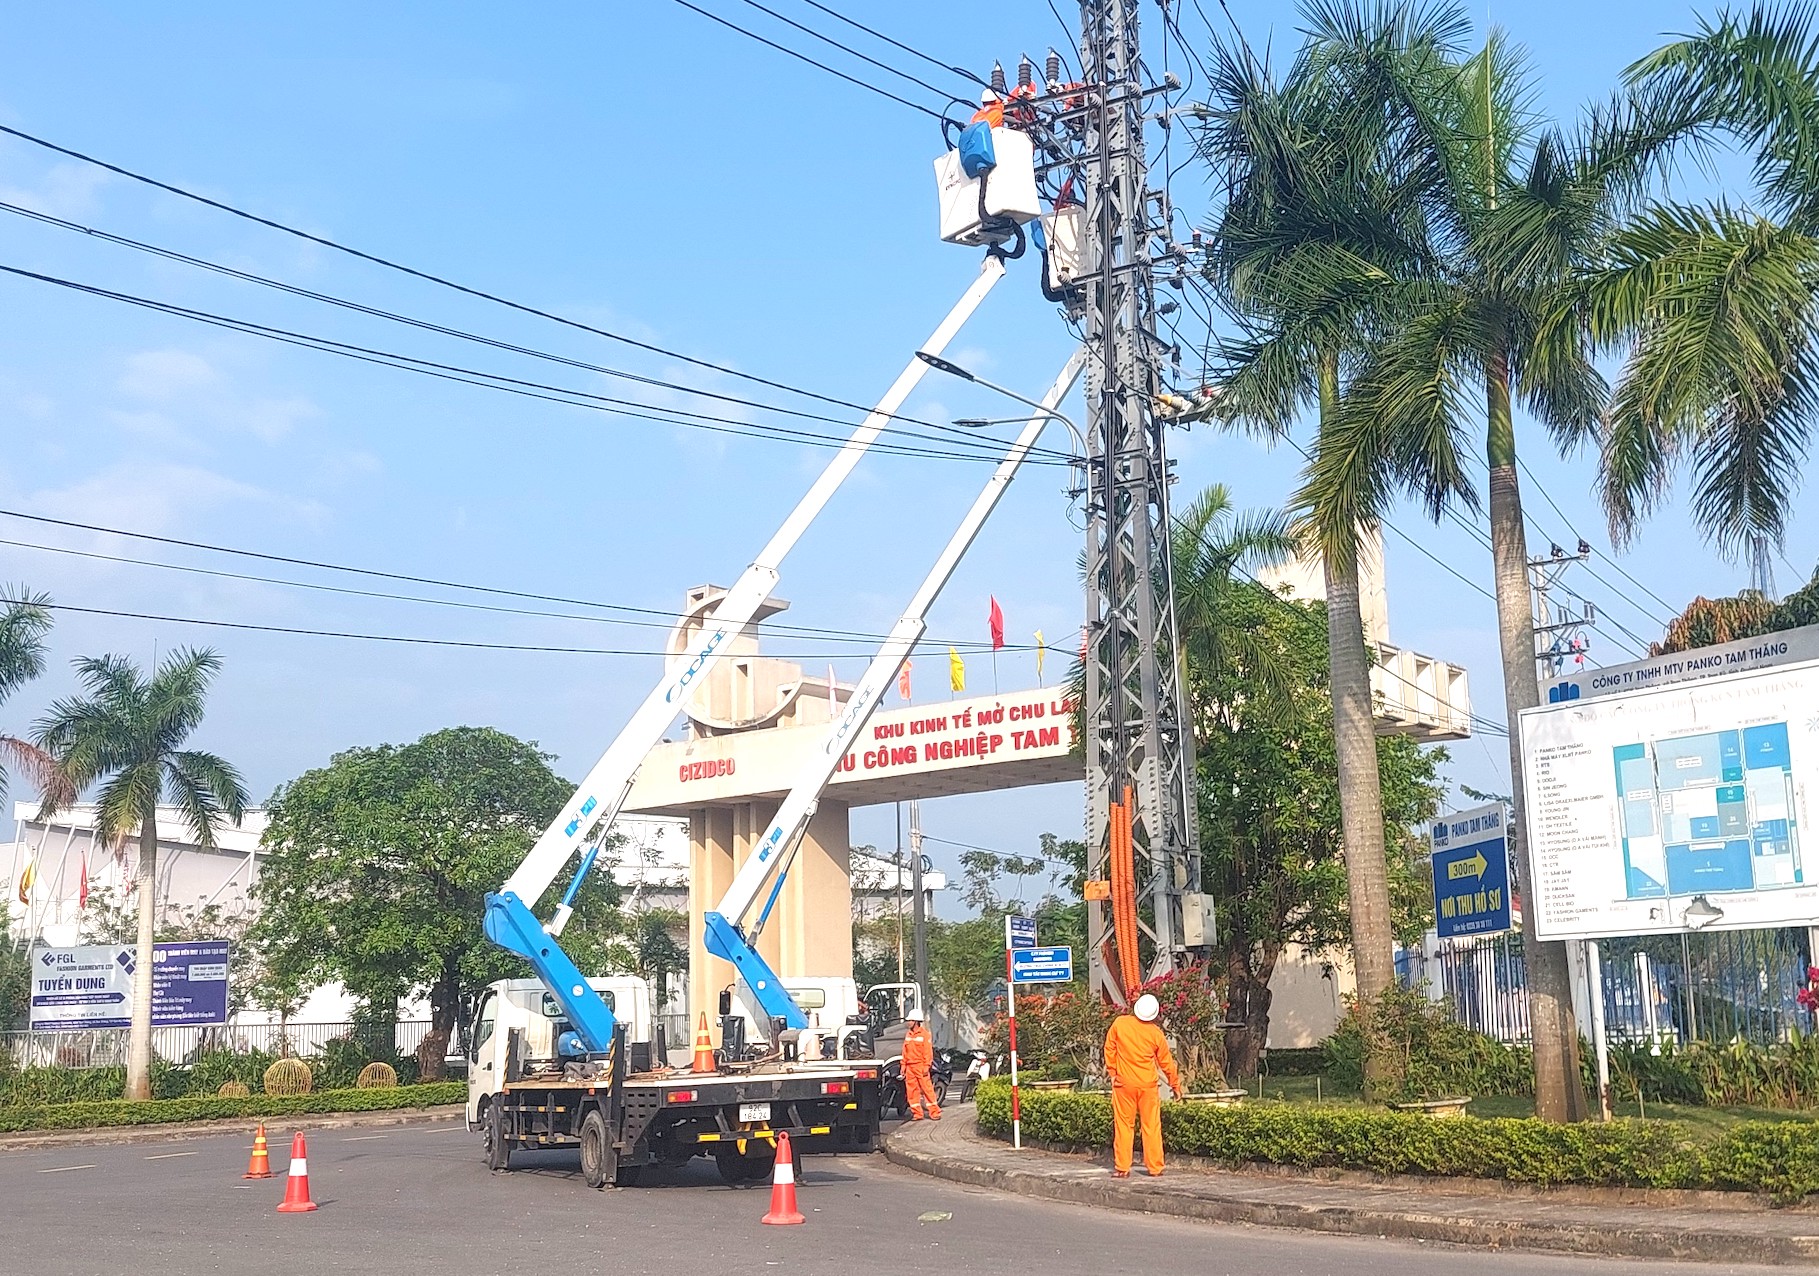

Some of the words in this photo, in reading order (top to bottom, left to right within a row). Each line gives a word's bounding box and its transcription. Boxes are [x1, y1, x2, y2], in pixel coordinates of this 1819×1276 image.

[1592, 674, 1620, 689] CÔNG
[1623, 672, 1634, 684] TY
[1636, 666, 1661, 681] TNHH
[1664, 662, 1684, 676] MTV
[1687, 655, 1722, 672] PANKO
[1724, 650, 1747, 664] TAM
[1749, 642, 1788, 660] THĂNG
[874, 722, 904, 740] KHU
[910, 716, 948, 736] KINH
[952, 706, 972, 729] TẾ
[978, 702, 1004, 726] MỞ
[1010, 702, 1045, 722] CHU
[864, 744, 918, 769] CÔNG
[925, 731, 1004, 760] NGHIỆP
[1011, 726, 1060, 750] TAM
[680, 758, 736, 782] CIZIDCO
[1452, 820, 1468, 838] PANKO
[1454, 862, 1476, 876] 300m
[1456, 894, 1473, 916] THU
[1489, 886, 1501, 912] SƠ
[57, 953, 76, 964] FGL
[38, 974, 72, 991] TUYỂN
[76, 977, 105, 992] DỤNG
